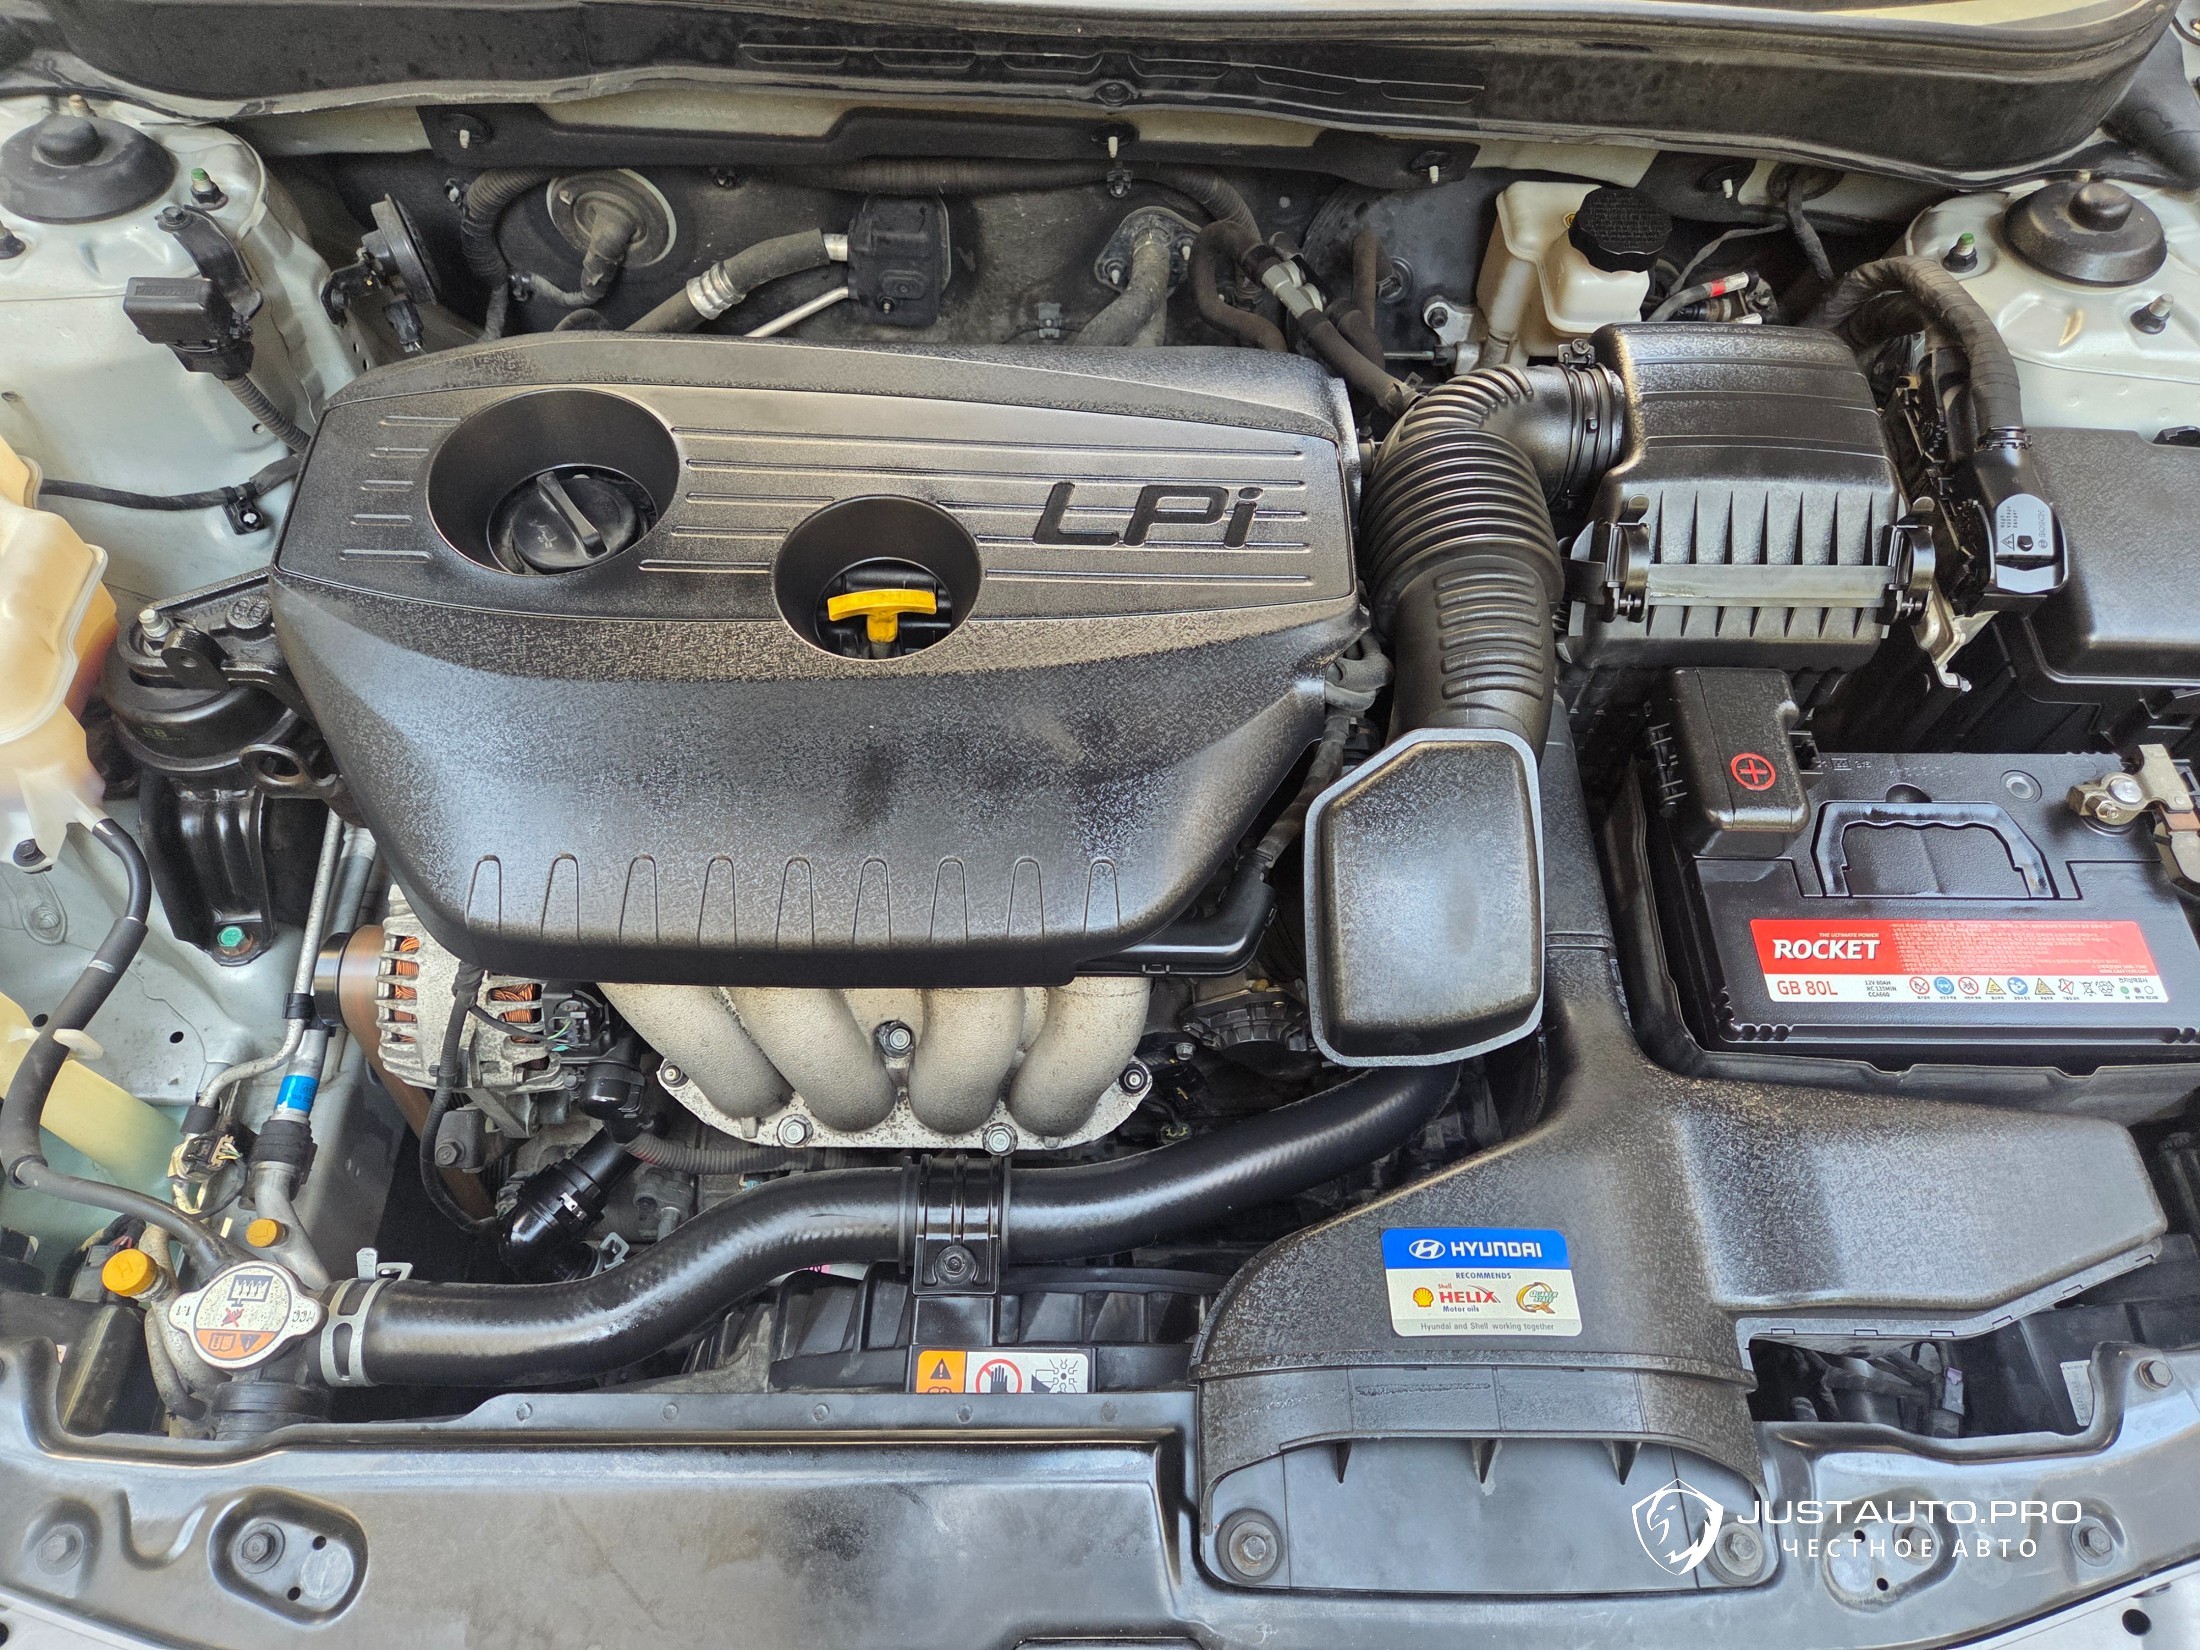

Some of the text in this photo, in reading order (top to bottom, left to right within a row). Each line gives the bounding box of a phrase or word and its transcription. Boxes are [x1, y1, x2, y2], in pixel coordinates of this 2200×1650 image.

[1032, 481, 1264, 549] LPi
[1772, 939, 1880, 959] ROCKET
[1777, 980, 1838, 995] GB 80L
[1450, 1241, 1543, 1258] HYUNDAI
[1455, 1272, 1512, 1280] RECOMMENDS
[1438, 1291, 1498, 1304] HELIX
[1420, 1322, 1554, 1331] Hyundai and Shell working together
